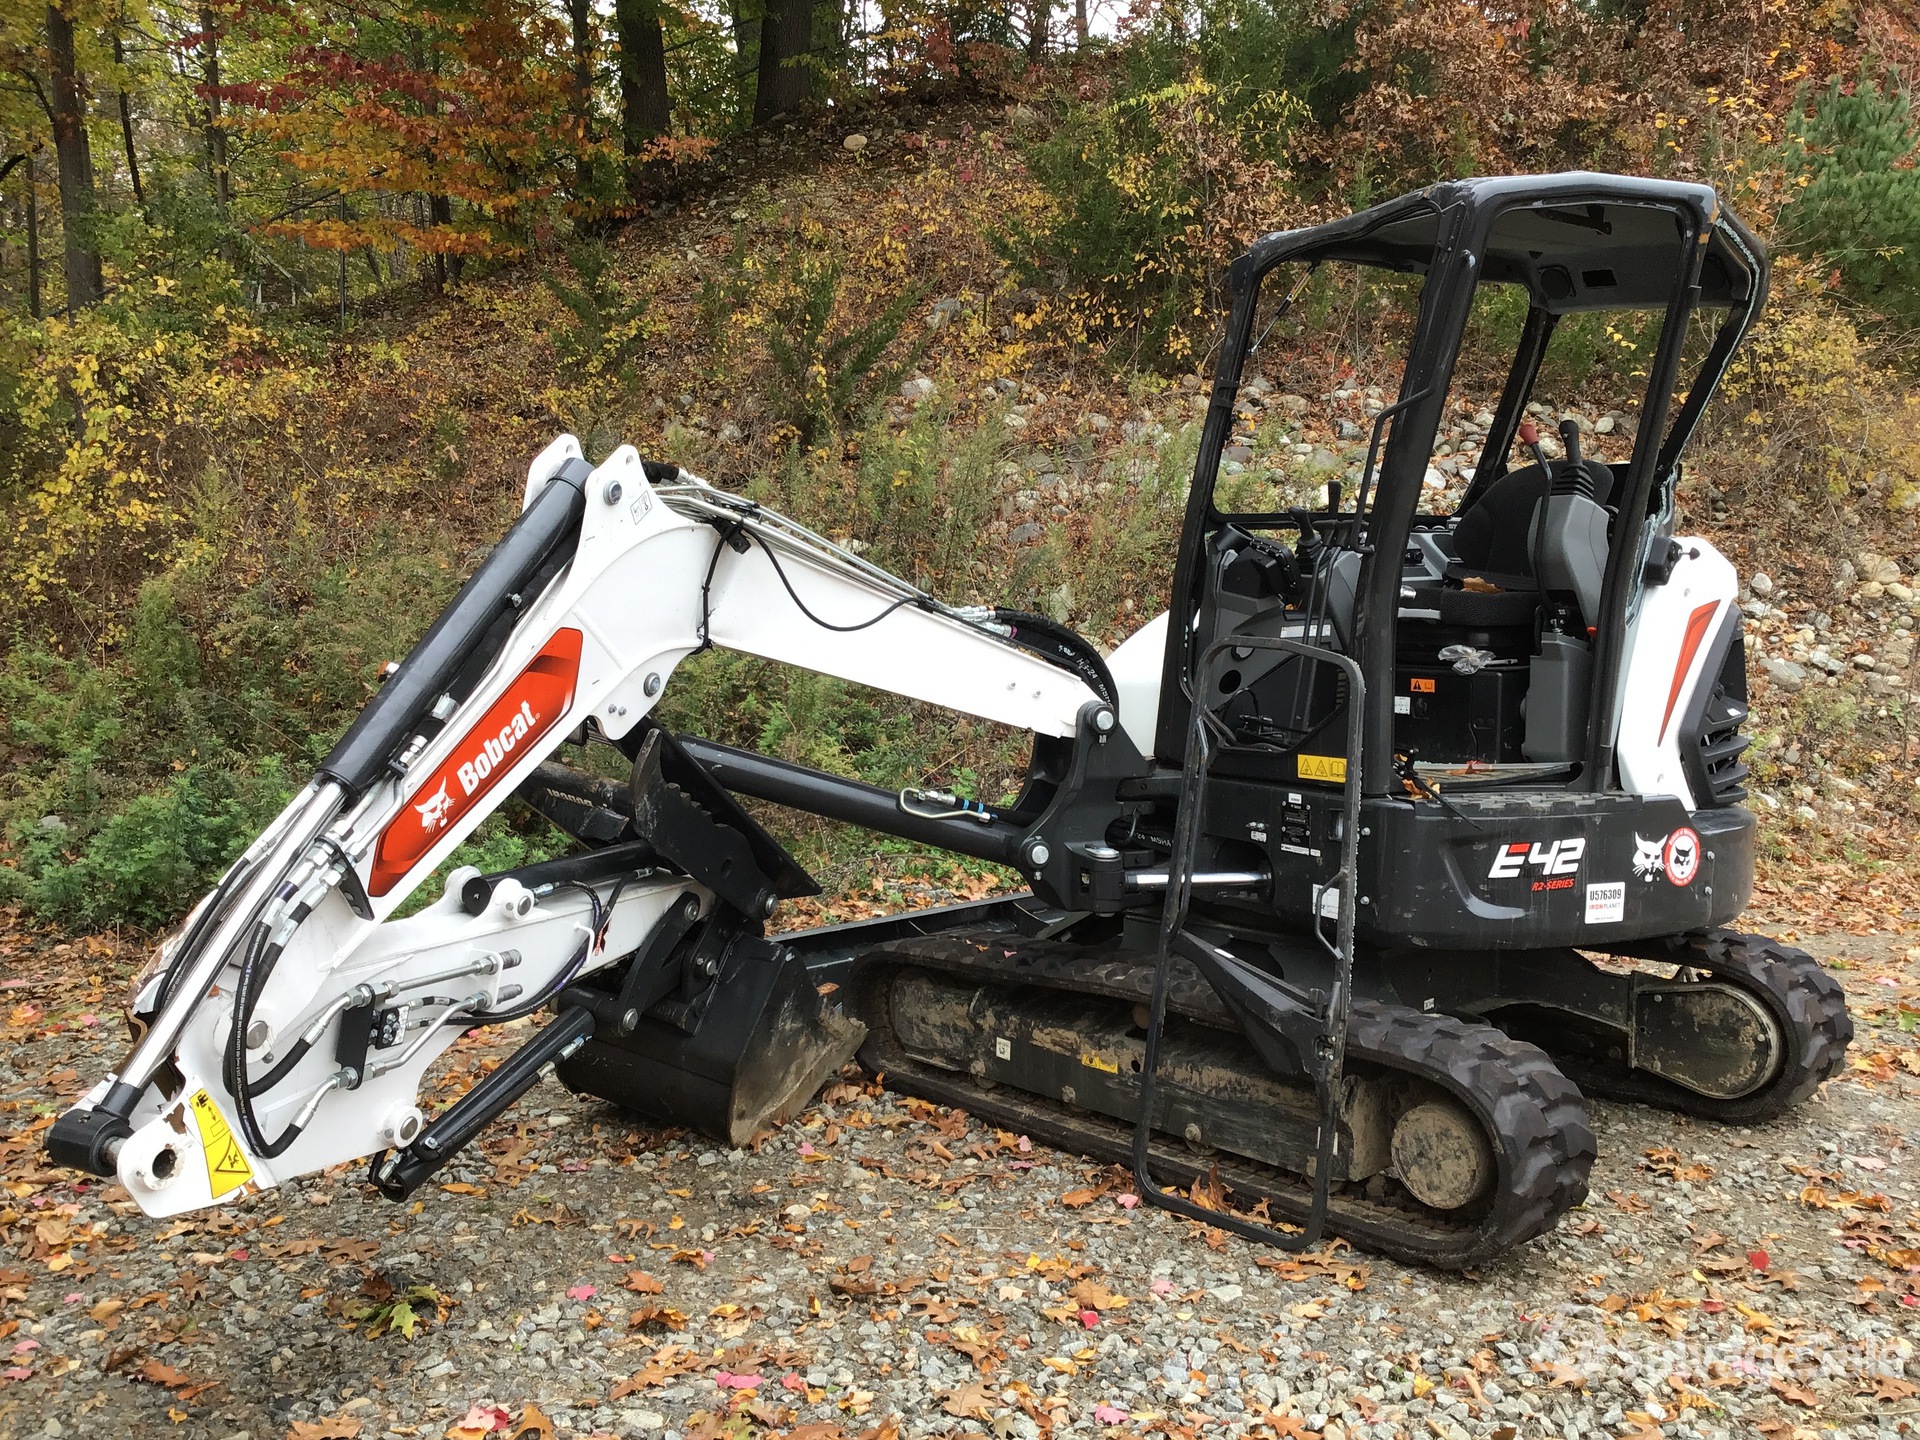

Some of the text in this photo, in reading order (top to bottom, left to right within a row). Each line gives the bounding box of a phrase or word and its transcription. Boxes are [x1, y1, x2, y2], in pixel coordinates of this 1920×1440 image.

[456, 699, 536, 797] Bobcat
[1487, 837, 1586, 879] E42
[1531, 878, 1575, 892] R2-SERIES
[1589, 888, 1622, 901] U576309
